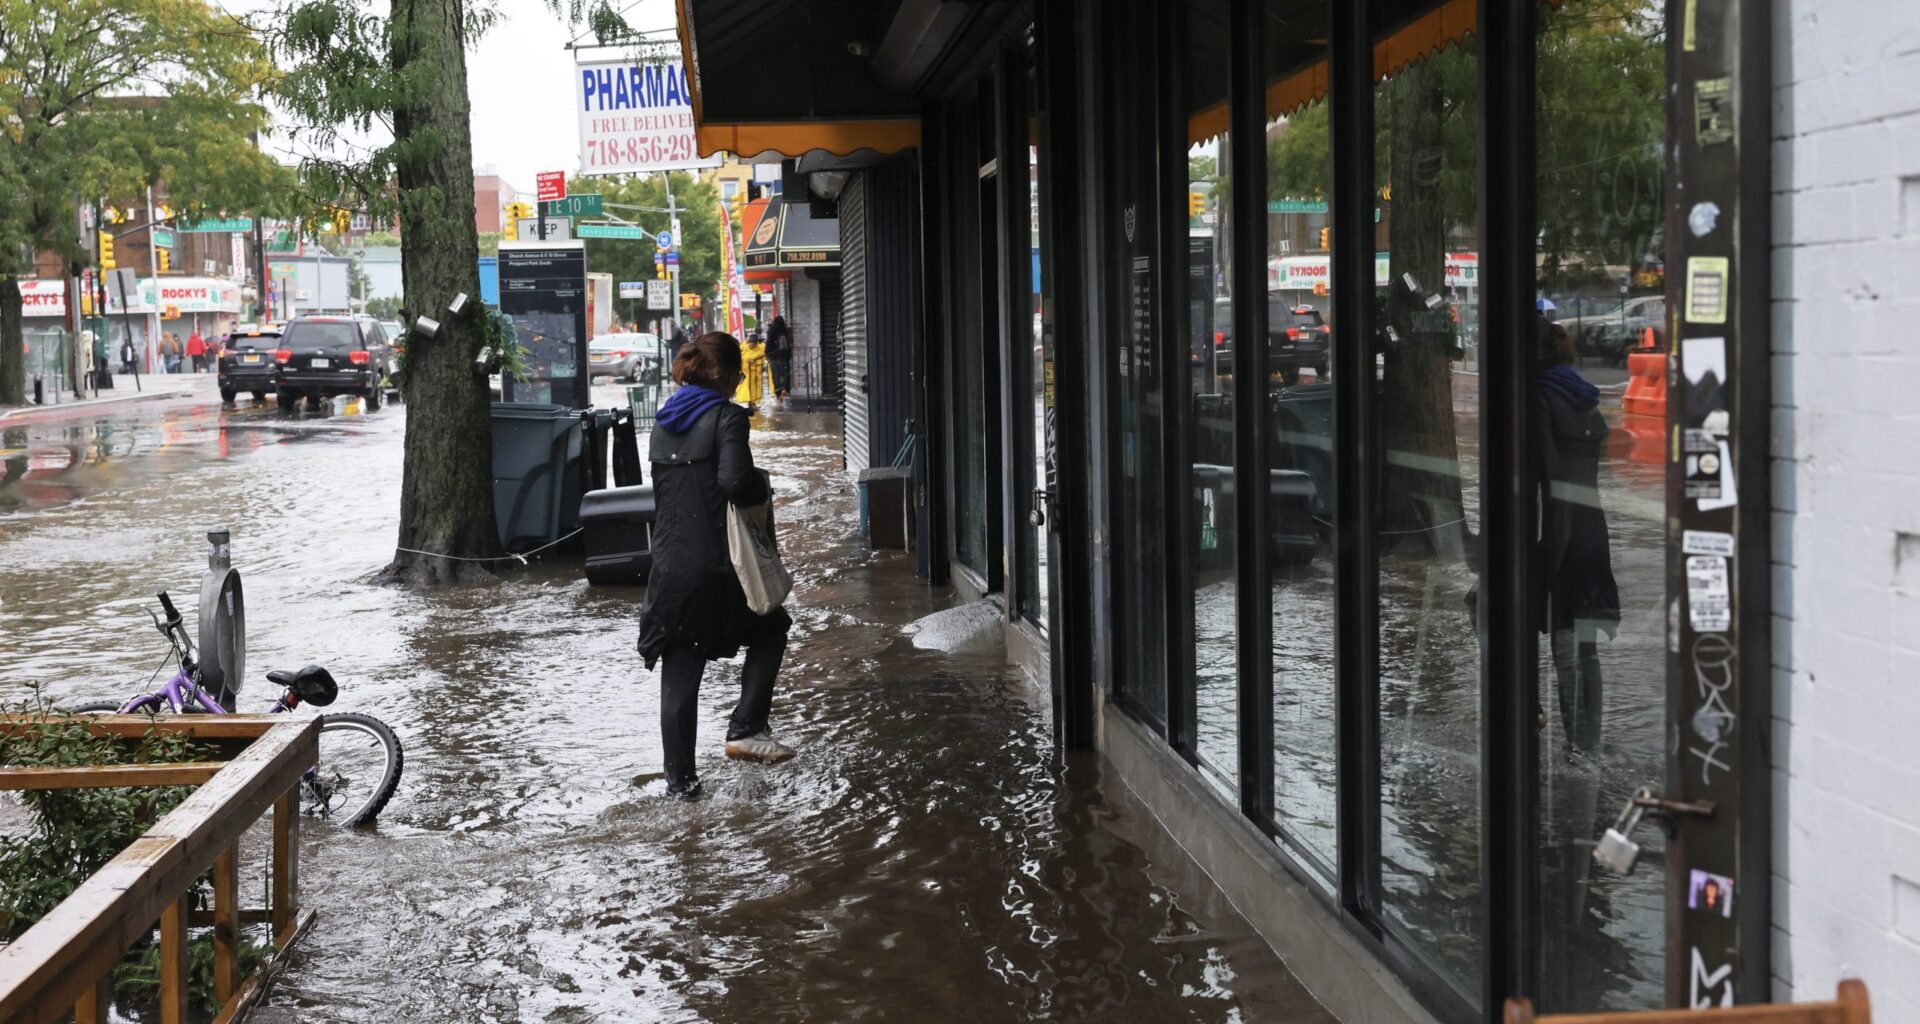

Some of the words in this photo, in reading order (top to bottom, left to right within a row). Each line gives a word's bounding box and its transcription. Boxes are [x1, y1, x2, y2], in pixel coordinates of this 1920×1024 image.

[592, 117, 630, 133] FREE
[587, 134, 698, 166] 718-856-29
[556, 199, 562, 214] E
[568, 198, 581, 213] 10
[587, 197, 595, 206] St
[22, 292, 58, 305] CKYS
[162, 288, 207, 299] ROCKYS
